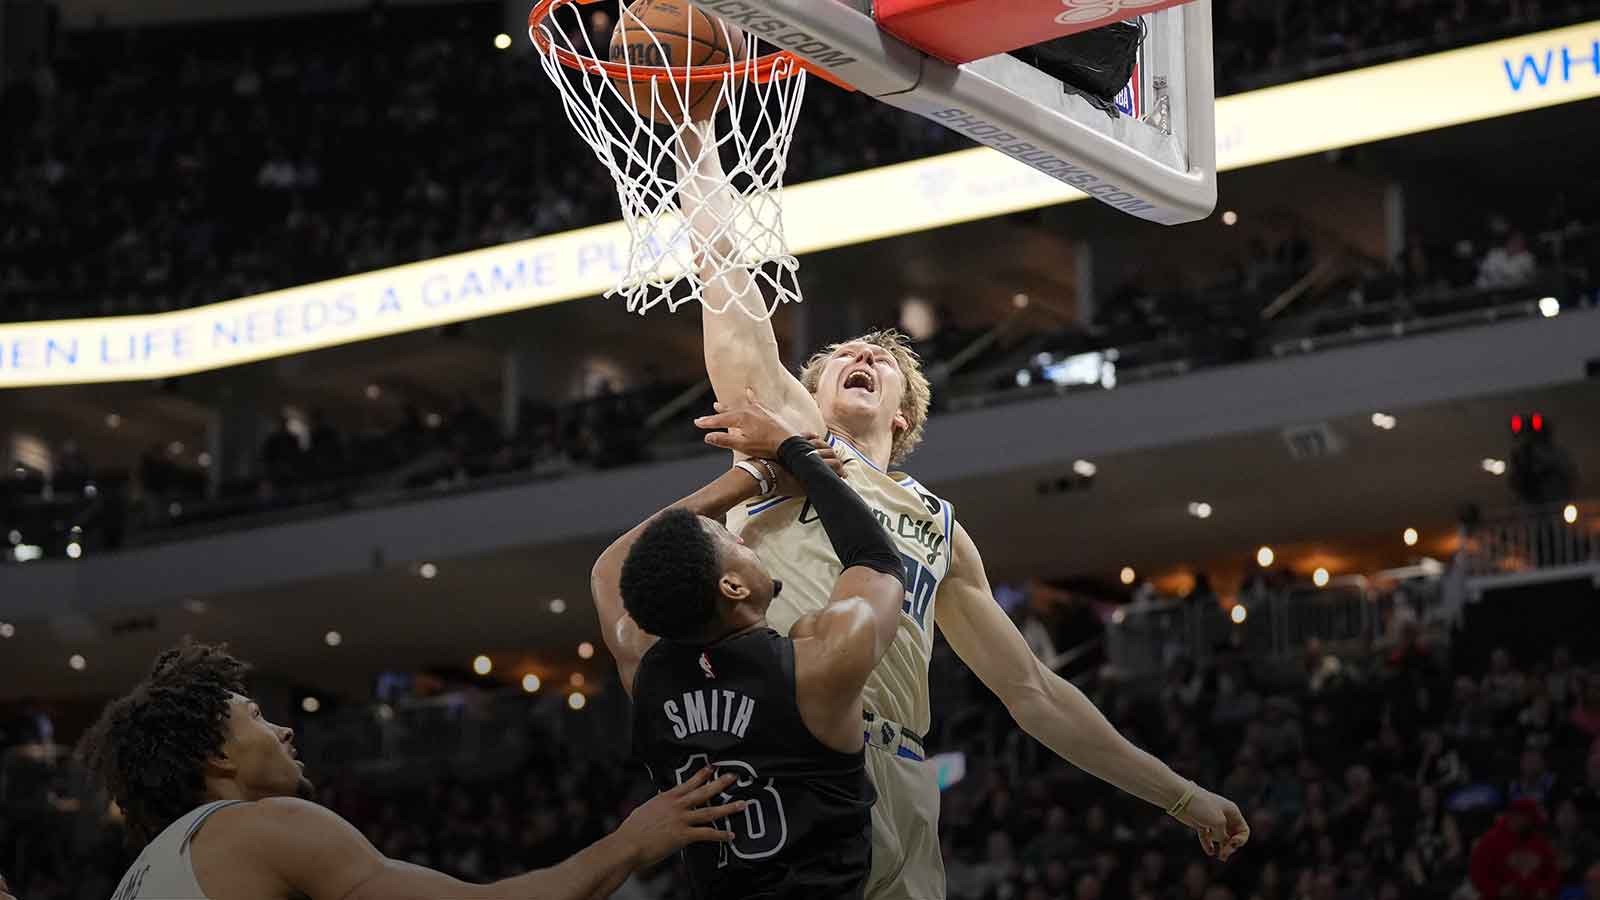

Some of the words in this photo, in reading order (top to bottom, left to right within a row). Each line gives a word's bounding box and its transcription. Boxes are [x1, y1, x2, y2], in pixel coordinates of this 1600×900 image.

[100, 329, 193, 365] LIFE
[211, 292, 358, 348] NEEDS
[376, 284, 402, 314] A
[420, 251, 557, 309] GAME
[898, 513, 945, 566] City
[663, 689, 756, 740] SMITH
